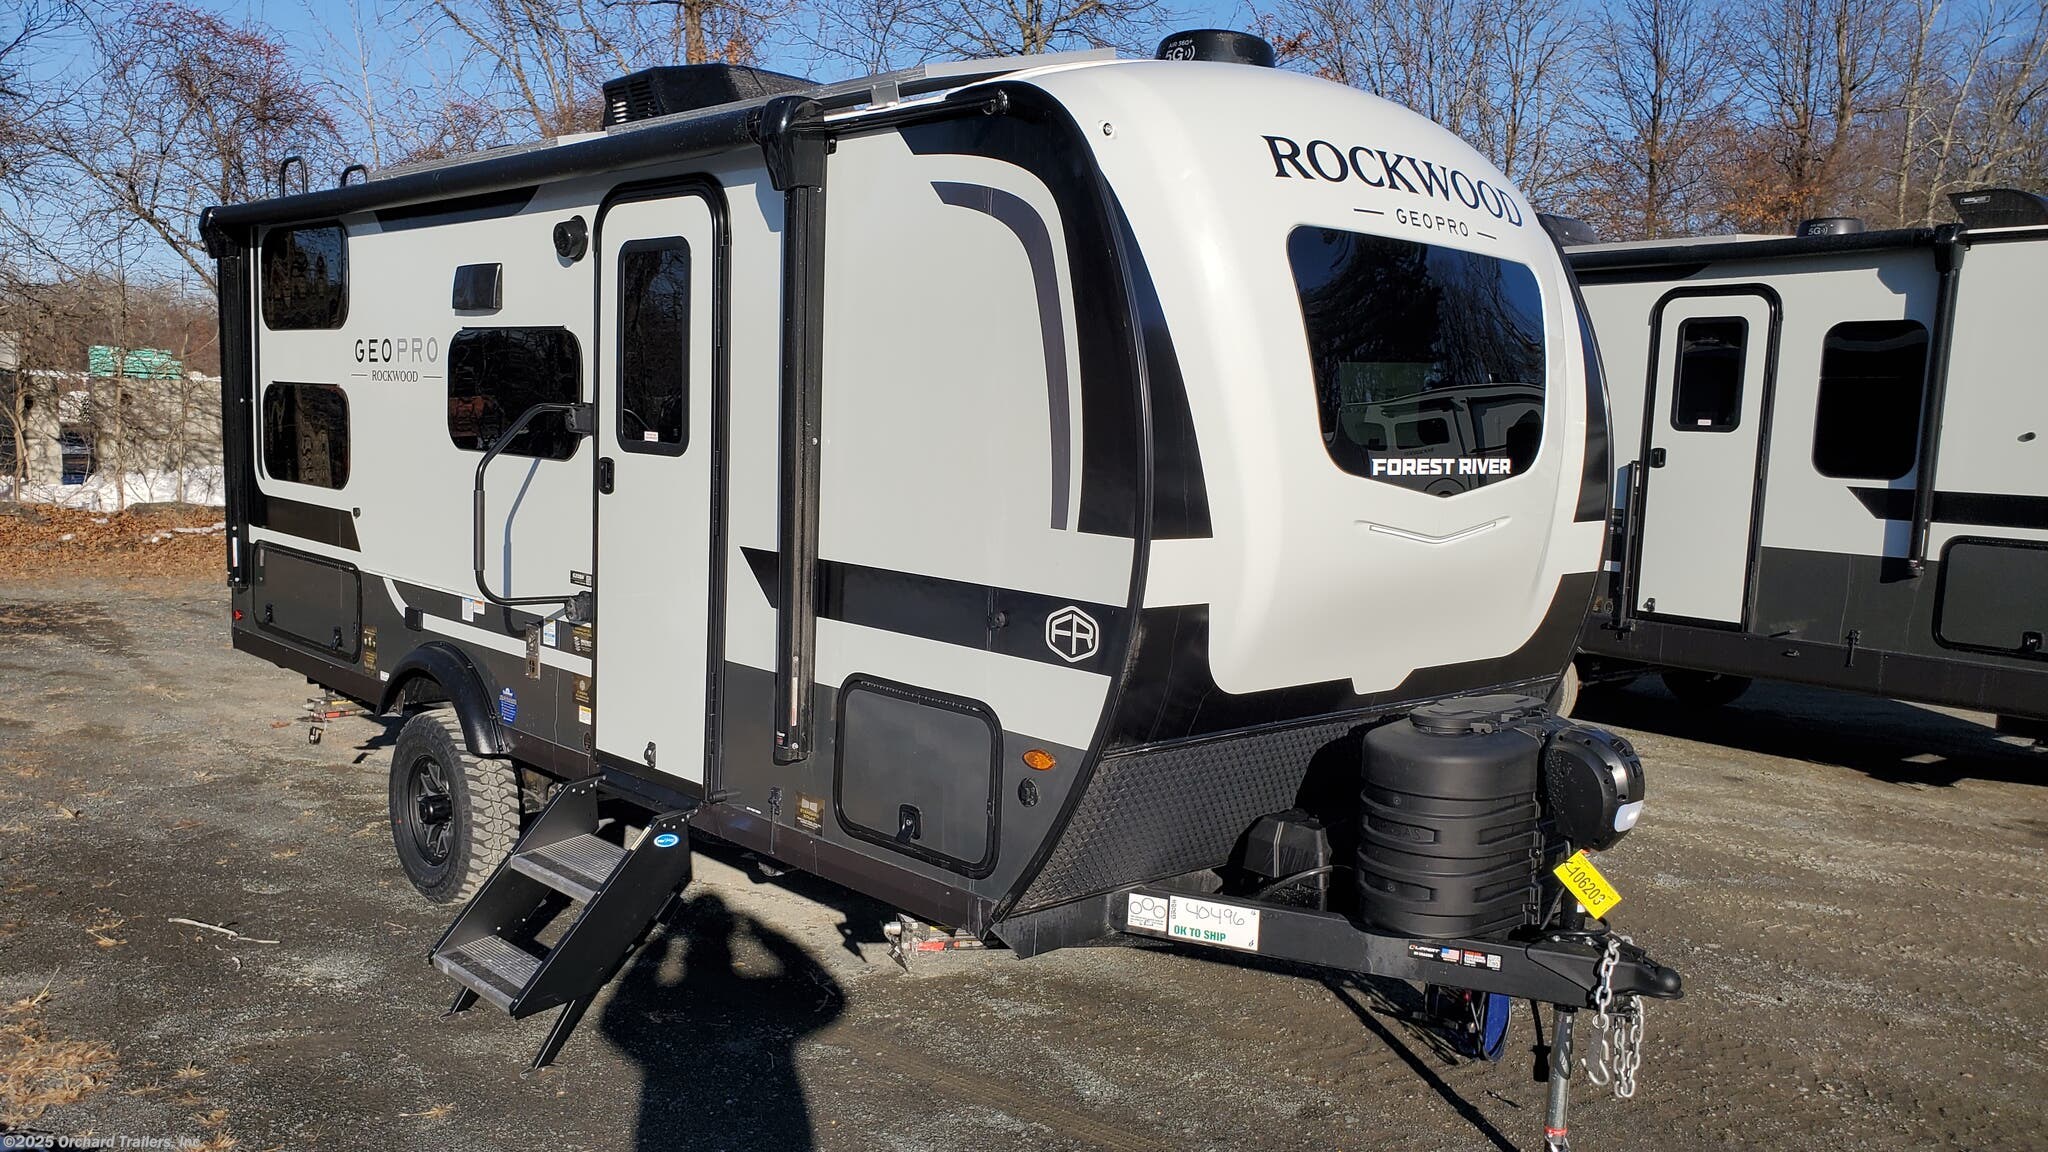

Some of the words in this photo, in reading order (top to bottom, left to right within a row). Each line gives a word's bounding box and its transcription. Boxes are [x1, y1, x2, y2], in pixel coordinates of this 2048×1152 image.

[1165, 47, 1184, 60] 5G
[1261, 135, 1523, 227] ROCKWOOD
[1396, 208, 1469, 237] GEOPRO
[1808, 227, 1821, 236] 5G
[354, 337, 438, 363] GEOPRO
[371, 370, 419, 382] ROCKWOOD
[1371, 458, 1455, 476] FOREST
[1458, 458, 1512, 475] RIVER
[1186, 902, 1245, 926] 40496
[1173, 924, 1187, 936] OK
[1189, 927, 1202, 938] TO
[1203, 930, 1226, 942] SHIP
